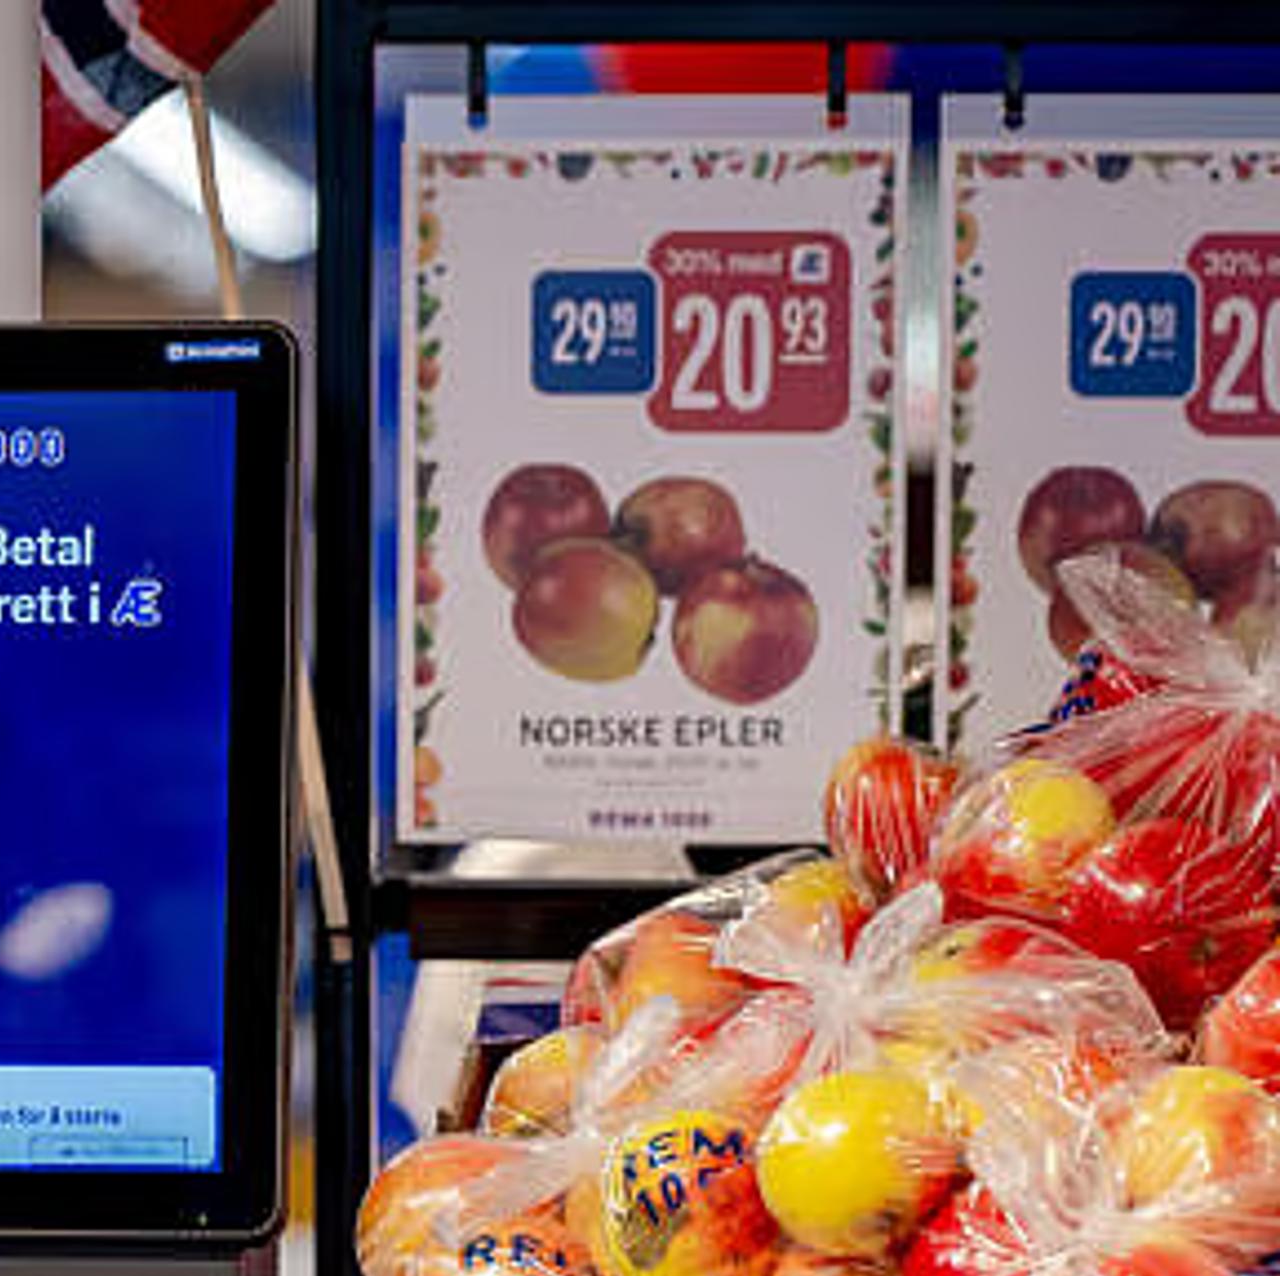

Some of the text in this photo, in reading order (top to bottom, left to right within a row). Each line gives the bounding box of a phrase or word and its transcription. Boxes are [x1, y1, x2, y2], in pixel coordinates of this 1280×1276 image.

[550, 298, 607, 365] 29
[670, 293, 828, 412] 20 93
[1089, 301, 1144, 367] 29
[88, 584, 102, 625] i
[110, 579, 163, 627] Æ
[519, 714, 785, 748] NORSKE EPLER
